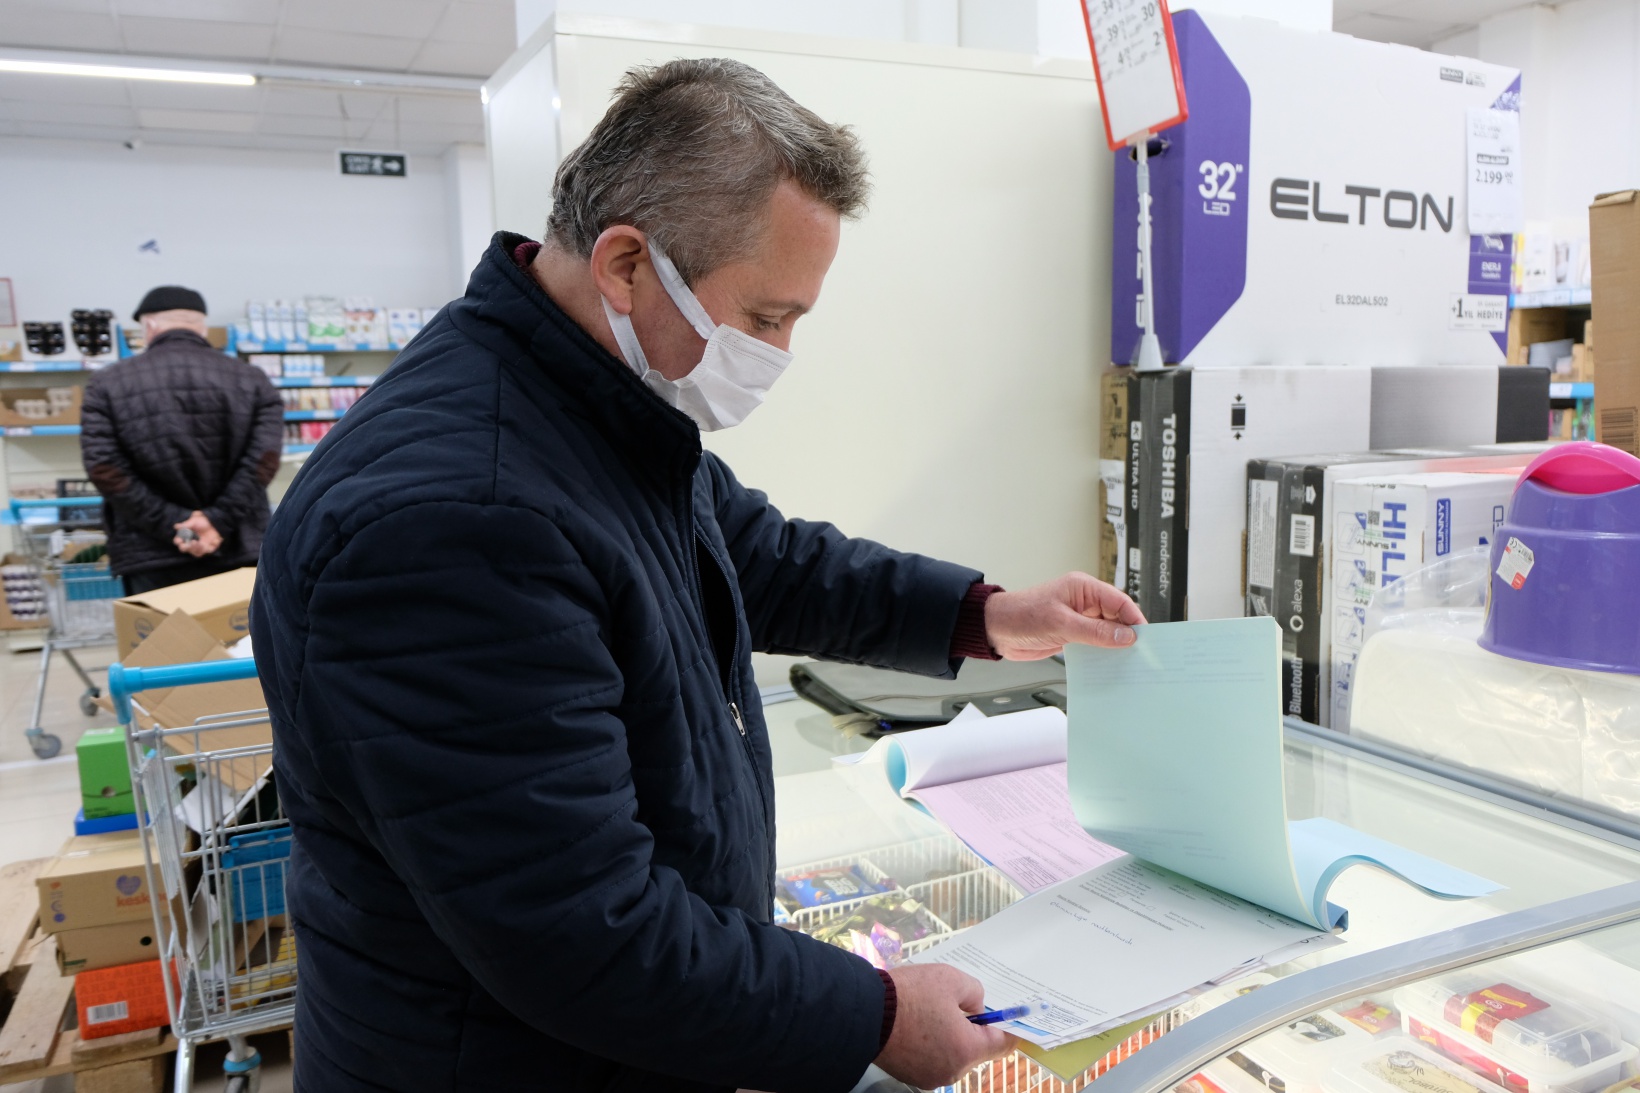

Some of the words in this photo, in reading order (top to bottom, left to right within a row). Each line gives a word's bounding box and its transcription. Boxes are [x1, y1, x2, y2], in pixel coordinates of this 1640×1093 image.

[1141, 2, 1155, 21] 30
[1107, 24, 1119, 42] 39
[1203, 201, 1230, 216] LED
[1270, 177, 1454, 233] ELTON
[1335, 294, 1388, 306] EL32DAL502
[1477, 308, 1503, 319] HEDİYE
[1131, 442, 1139, 486] ULTRA
[1161, 413, 1176, 518] TOSHIBA
[1131, 488, 1138, 510] HD
[1437, 502, 1445, 553] SUNNY
[1291, 579, 1303, 613] alexa
[1289, 657, 1303, 714] Bluetooth
